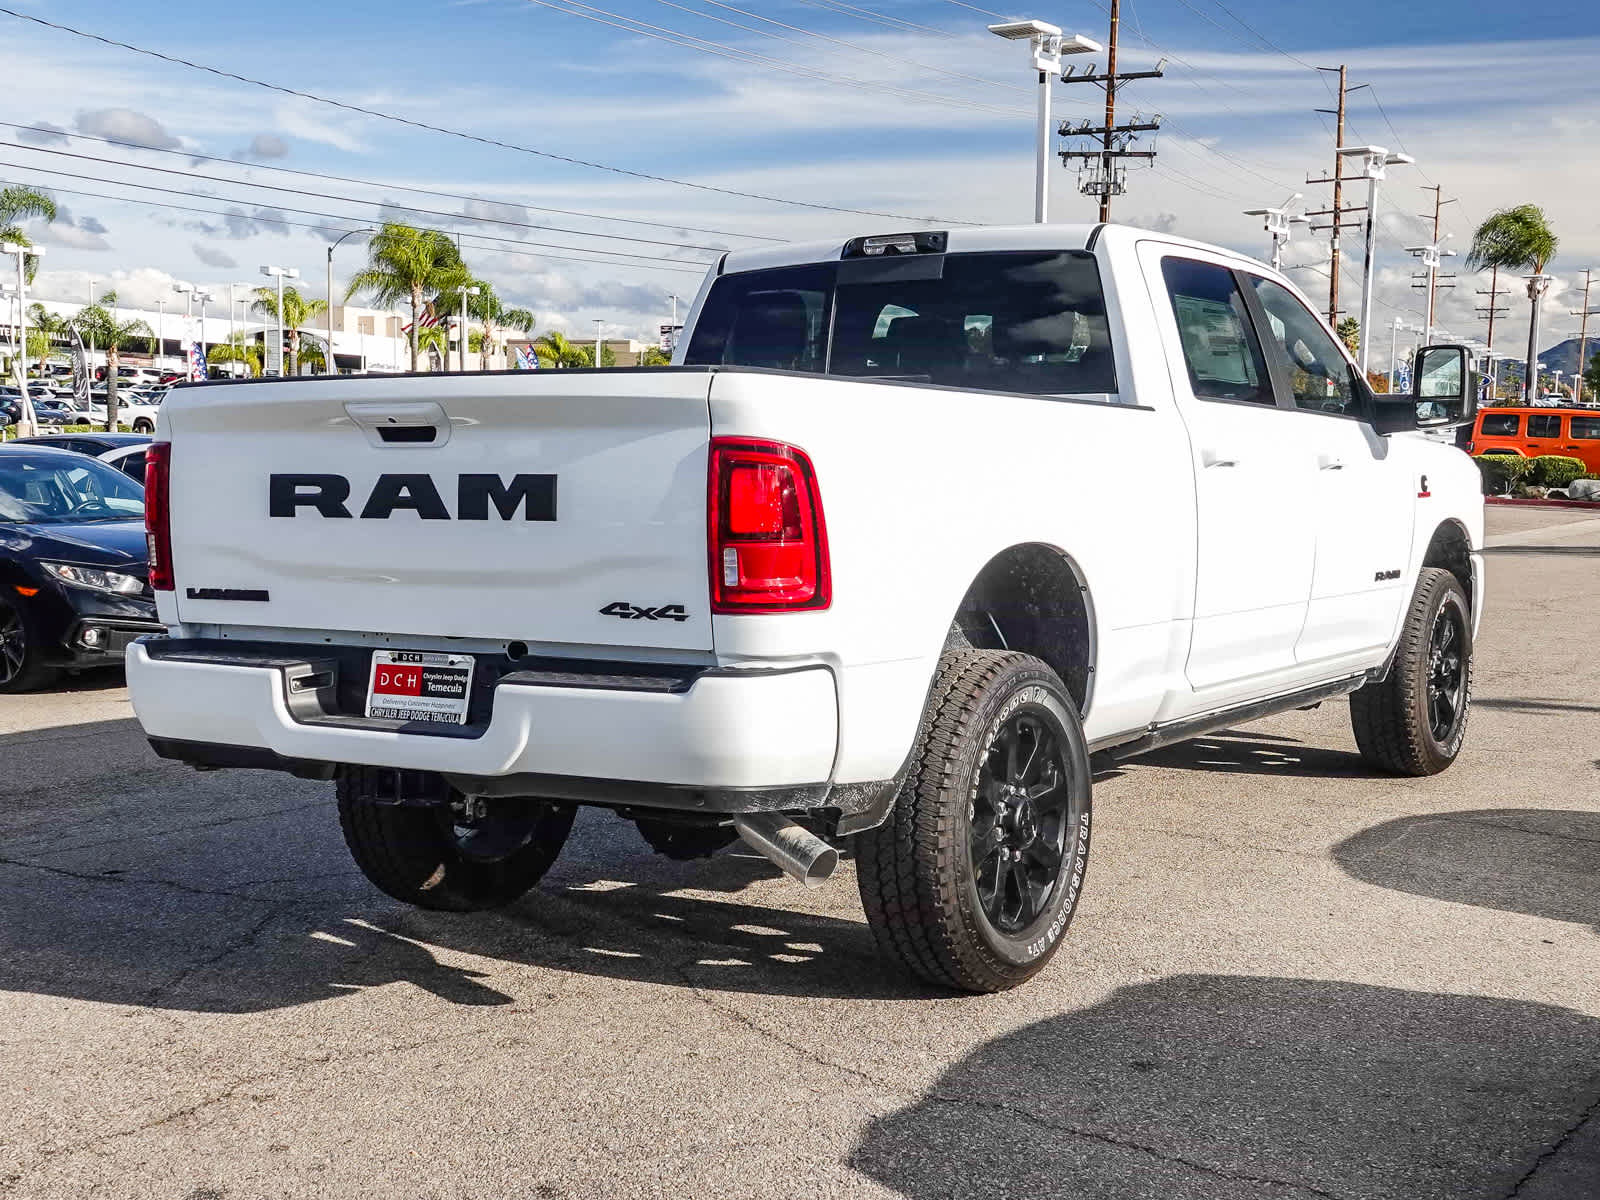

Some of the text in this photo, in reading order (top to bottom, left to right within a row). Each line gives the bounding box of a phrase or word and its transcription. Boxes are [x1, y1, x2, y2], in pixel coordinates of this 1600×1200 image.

[269, 473, 558, 522] RAM
[598, 602, 691, 622] 4x4
[402, 653, 420, 662] DCH
[380, 672, 417, 689] DCH
[422, 672, 443, 682] Chrysler
[427, 682, 463, 693] Temecula
[370, 707, 459, 724] CHRYSLER JEEP DODGE TEMECULA
